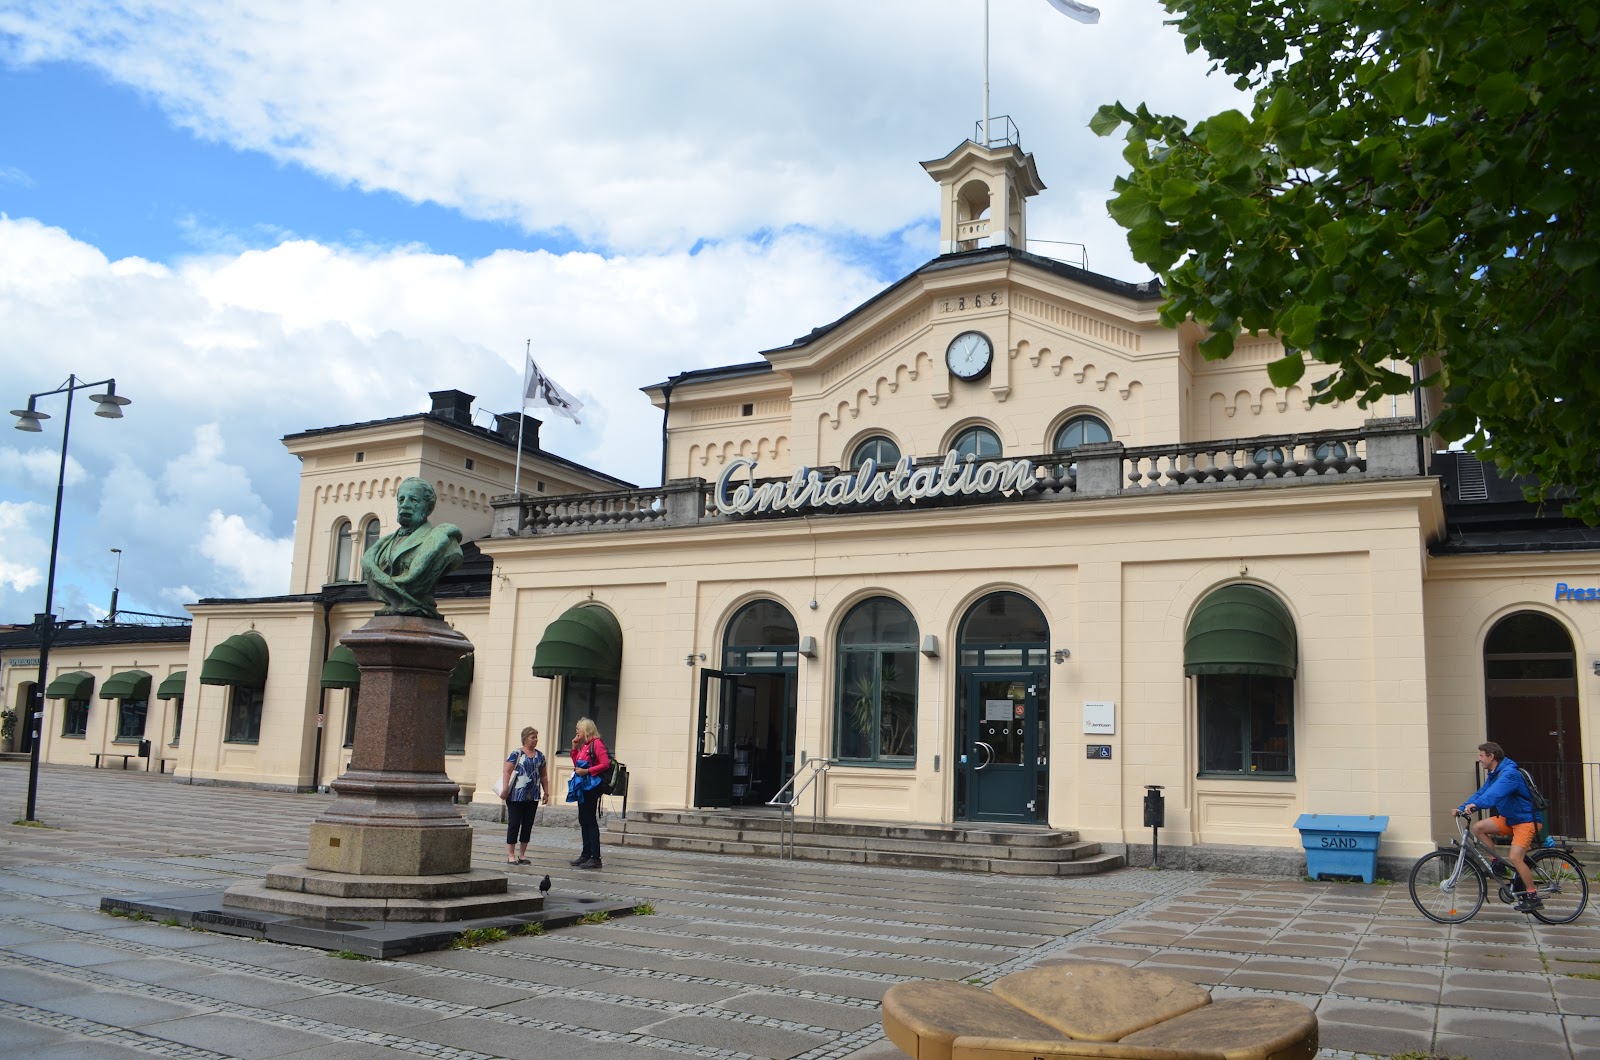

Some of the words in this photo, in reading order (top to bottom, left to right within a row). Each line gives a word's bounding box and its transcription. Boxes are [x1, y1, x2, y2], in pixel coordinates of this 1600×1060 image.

[945, 292, 998, 313] 1862
[714, 449, 1038, 515] Centralstation
[1555, 582, 1600, 601] Pres
[1321, 837, 1357, 848] SAND
